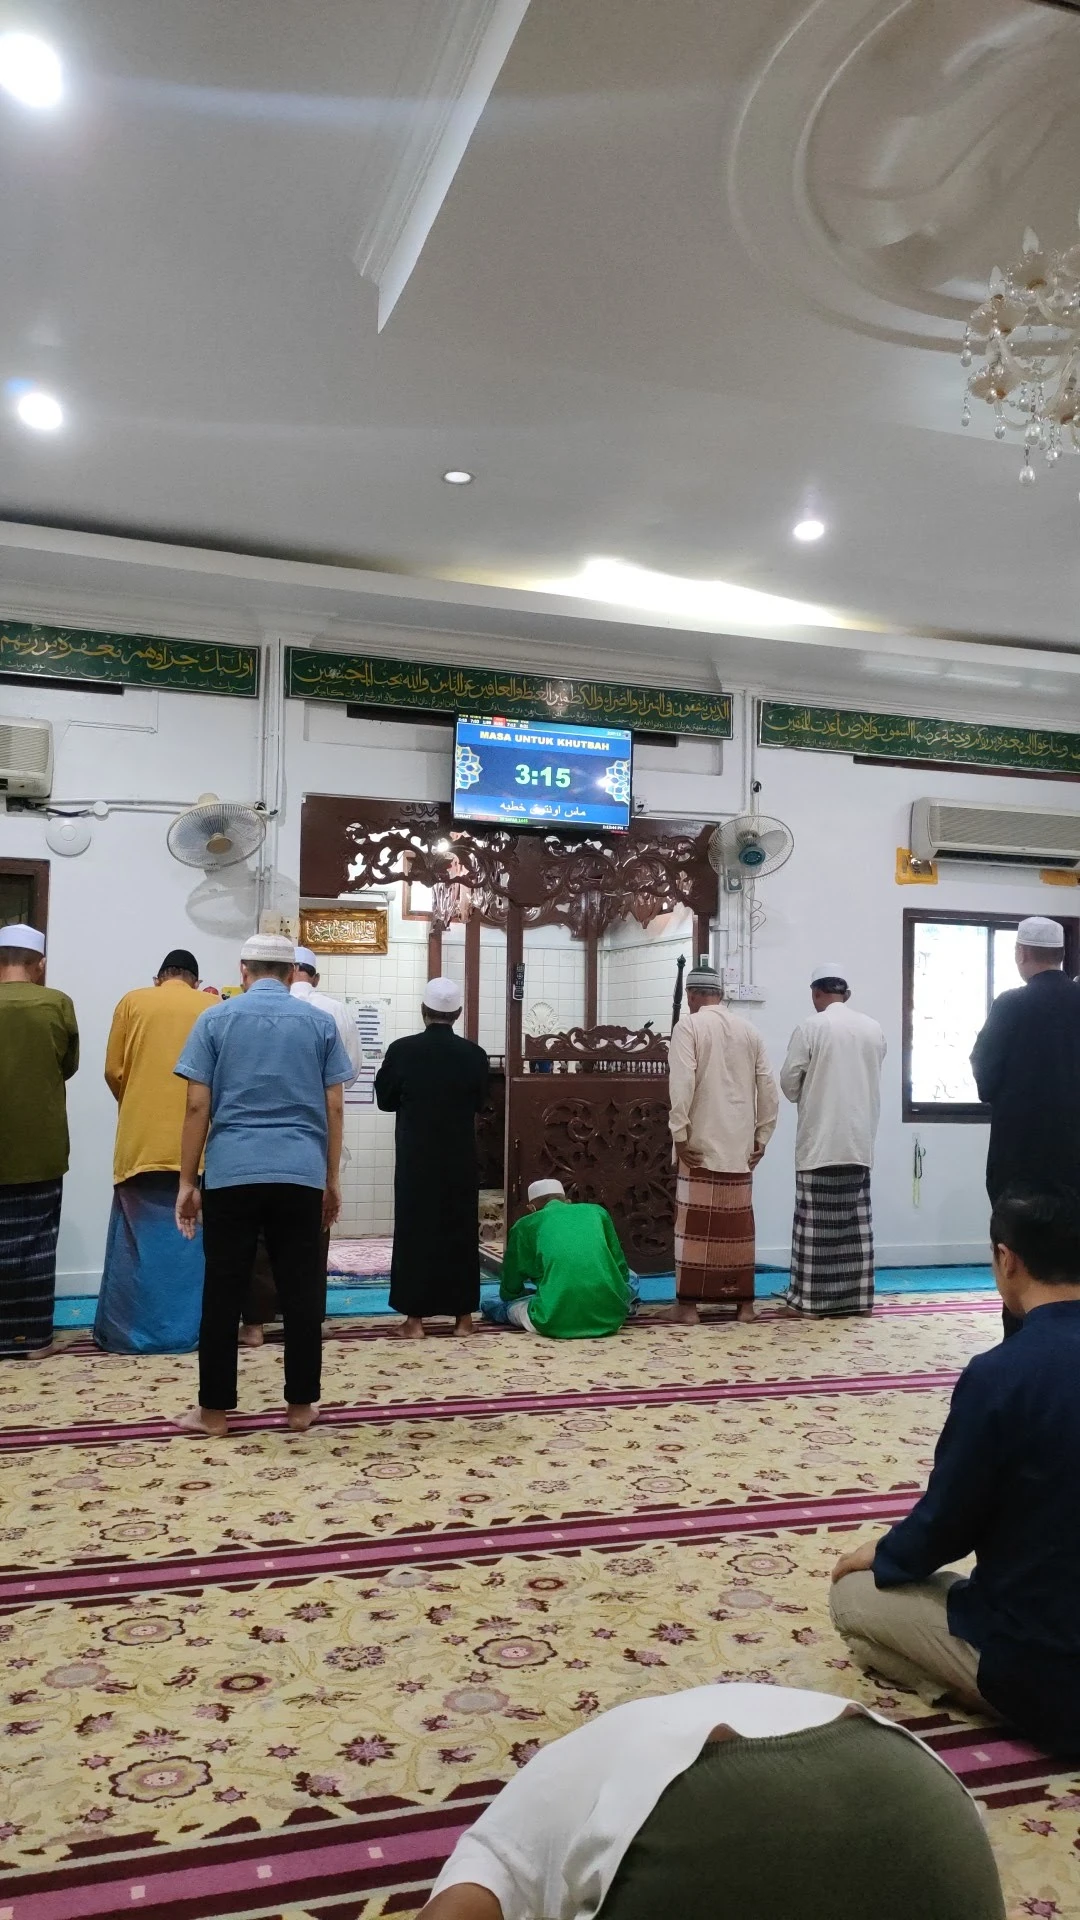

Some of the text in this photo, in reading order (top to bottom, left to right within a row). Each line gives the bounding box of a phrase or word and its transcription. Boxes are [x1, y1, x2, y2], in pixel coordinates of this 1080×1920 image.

[480, 730, 610, 751] MASA UNTUK KHUTBAH
[515, 764, 571, 788] 3:15
